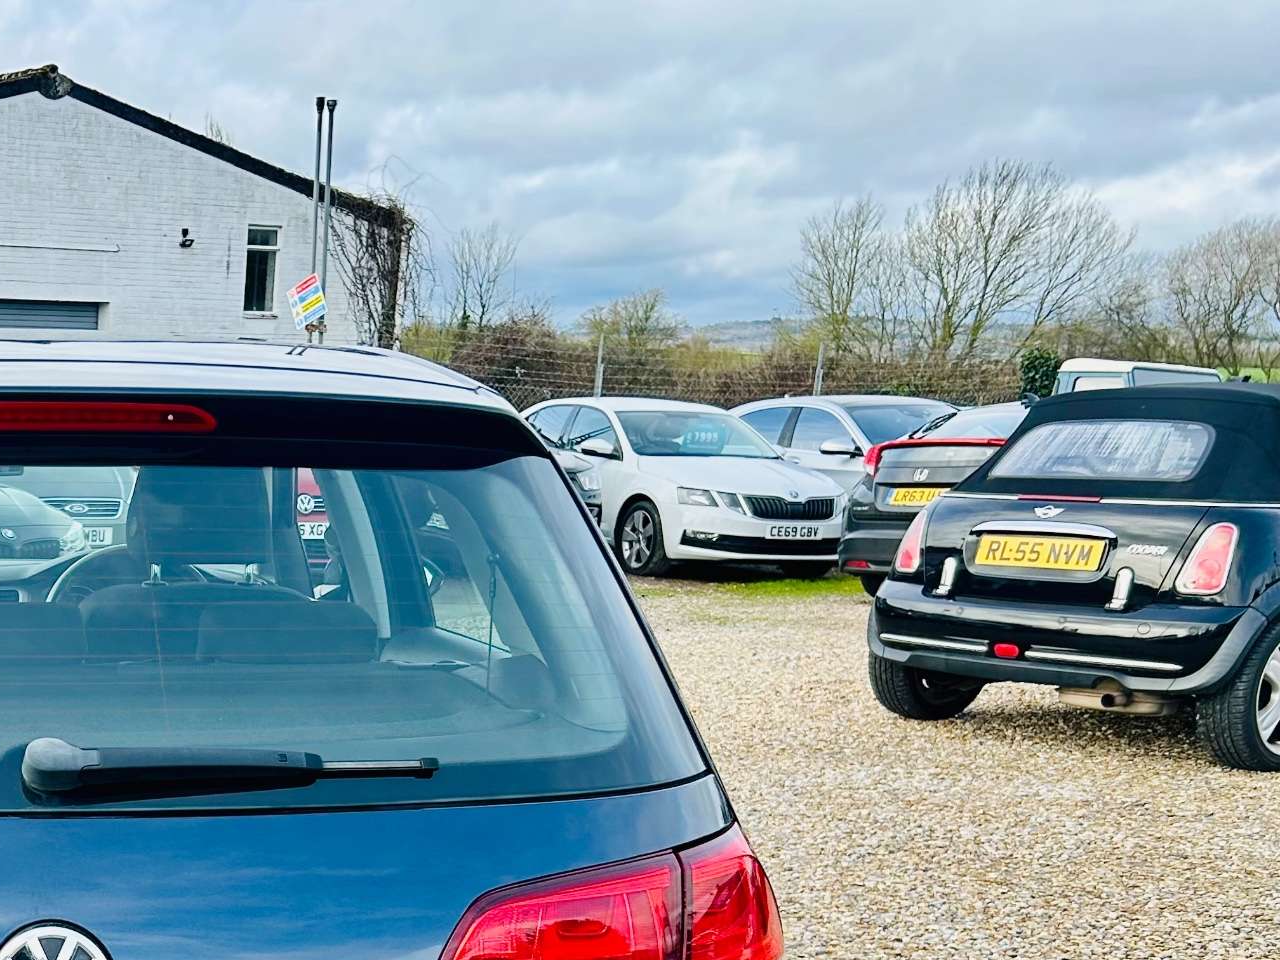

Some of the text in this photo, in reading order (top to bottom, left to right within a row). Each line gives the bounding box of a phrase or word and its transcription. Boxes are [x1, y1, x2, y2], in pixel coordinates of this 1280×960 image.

[893, 490, 925, 502] LR63
[770, 526, 798, 537] CE69
[985, 540, 1094, 567] RL55 NVM
